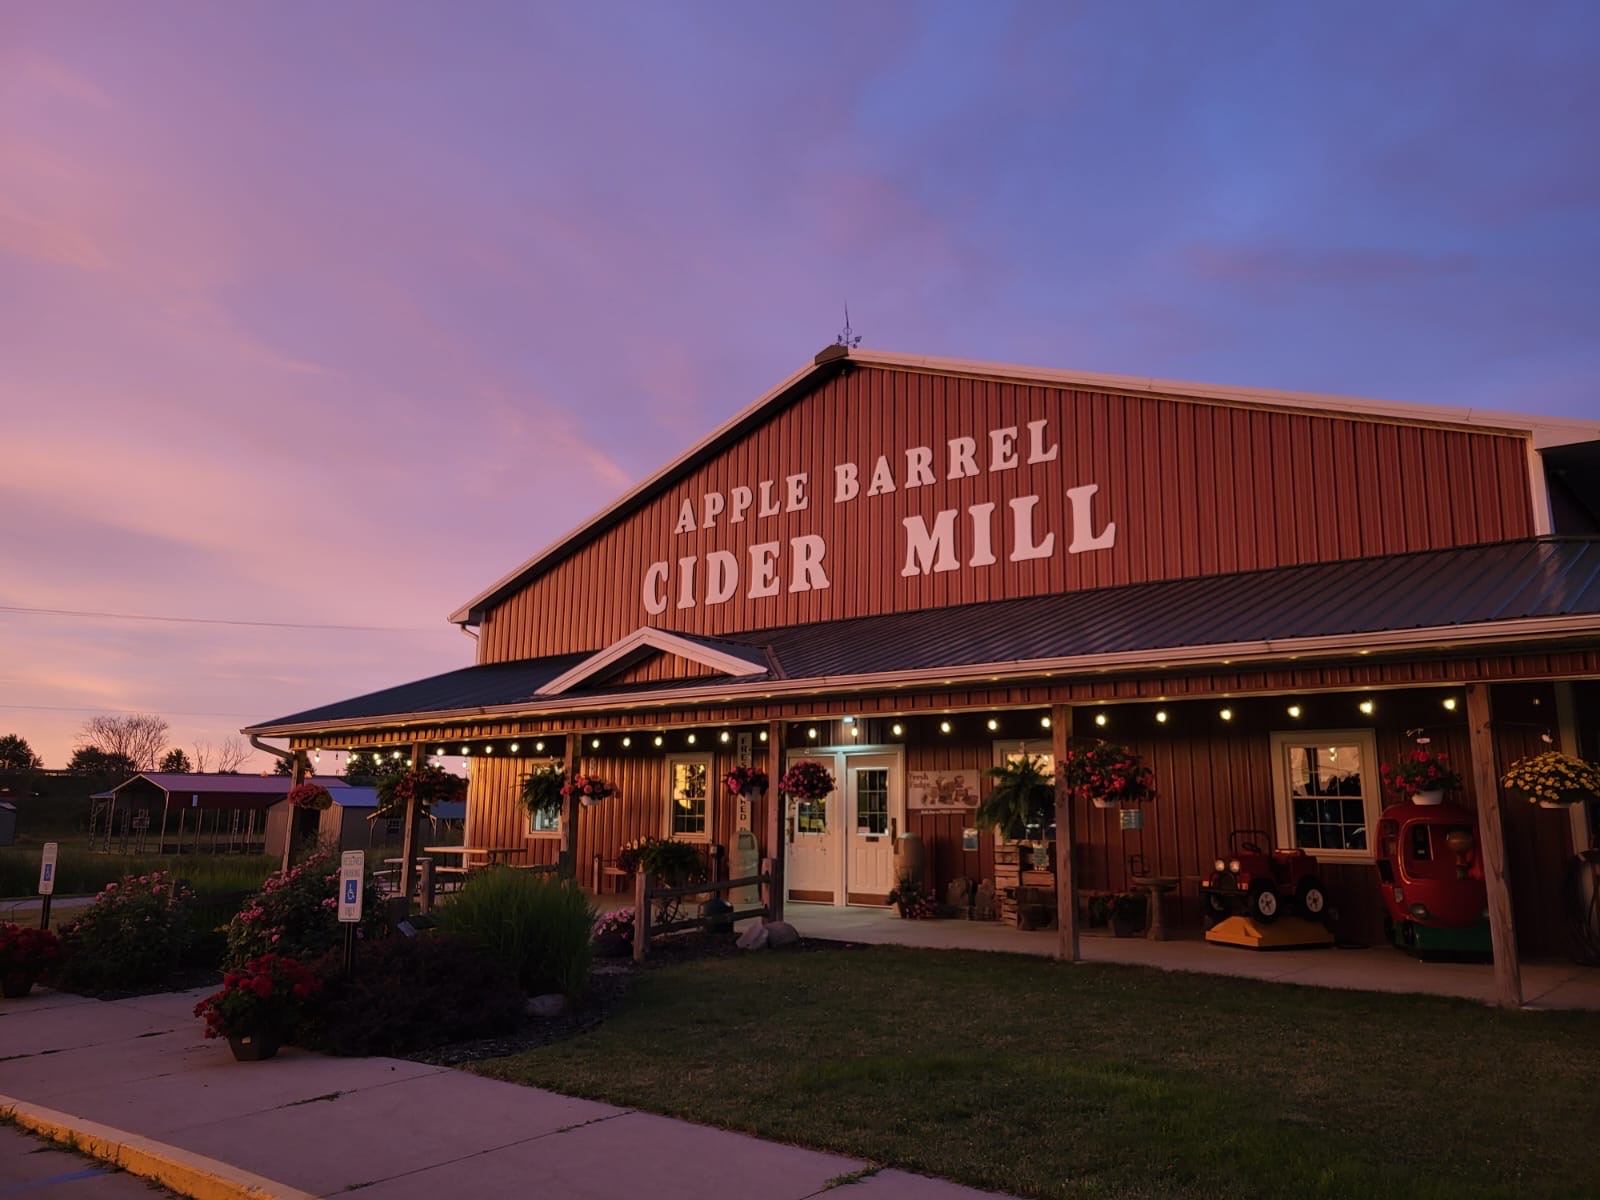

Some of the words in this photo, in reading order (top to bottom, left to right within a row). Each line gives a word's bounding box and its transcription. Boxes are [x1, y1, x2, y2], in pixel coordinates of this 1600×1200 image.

[674, 473, 808, 534] APPLE
[835, 420, 1057, 502] BARREL
[643, 534, 830, 614] CIDER
[901, 484, 1115, 577] MILL
